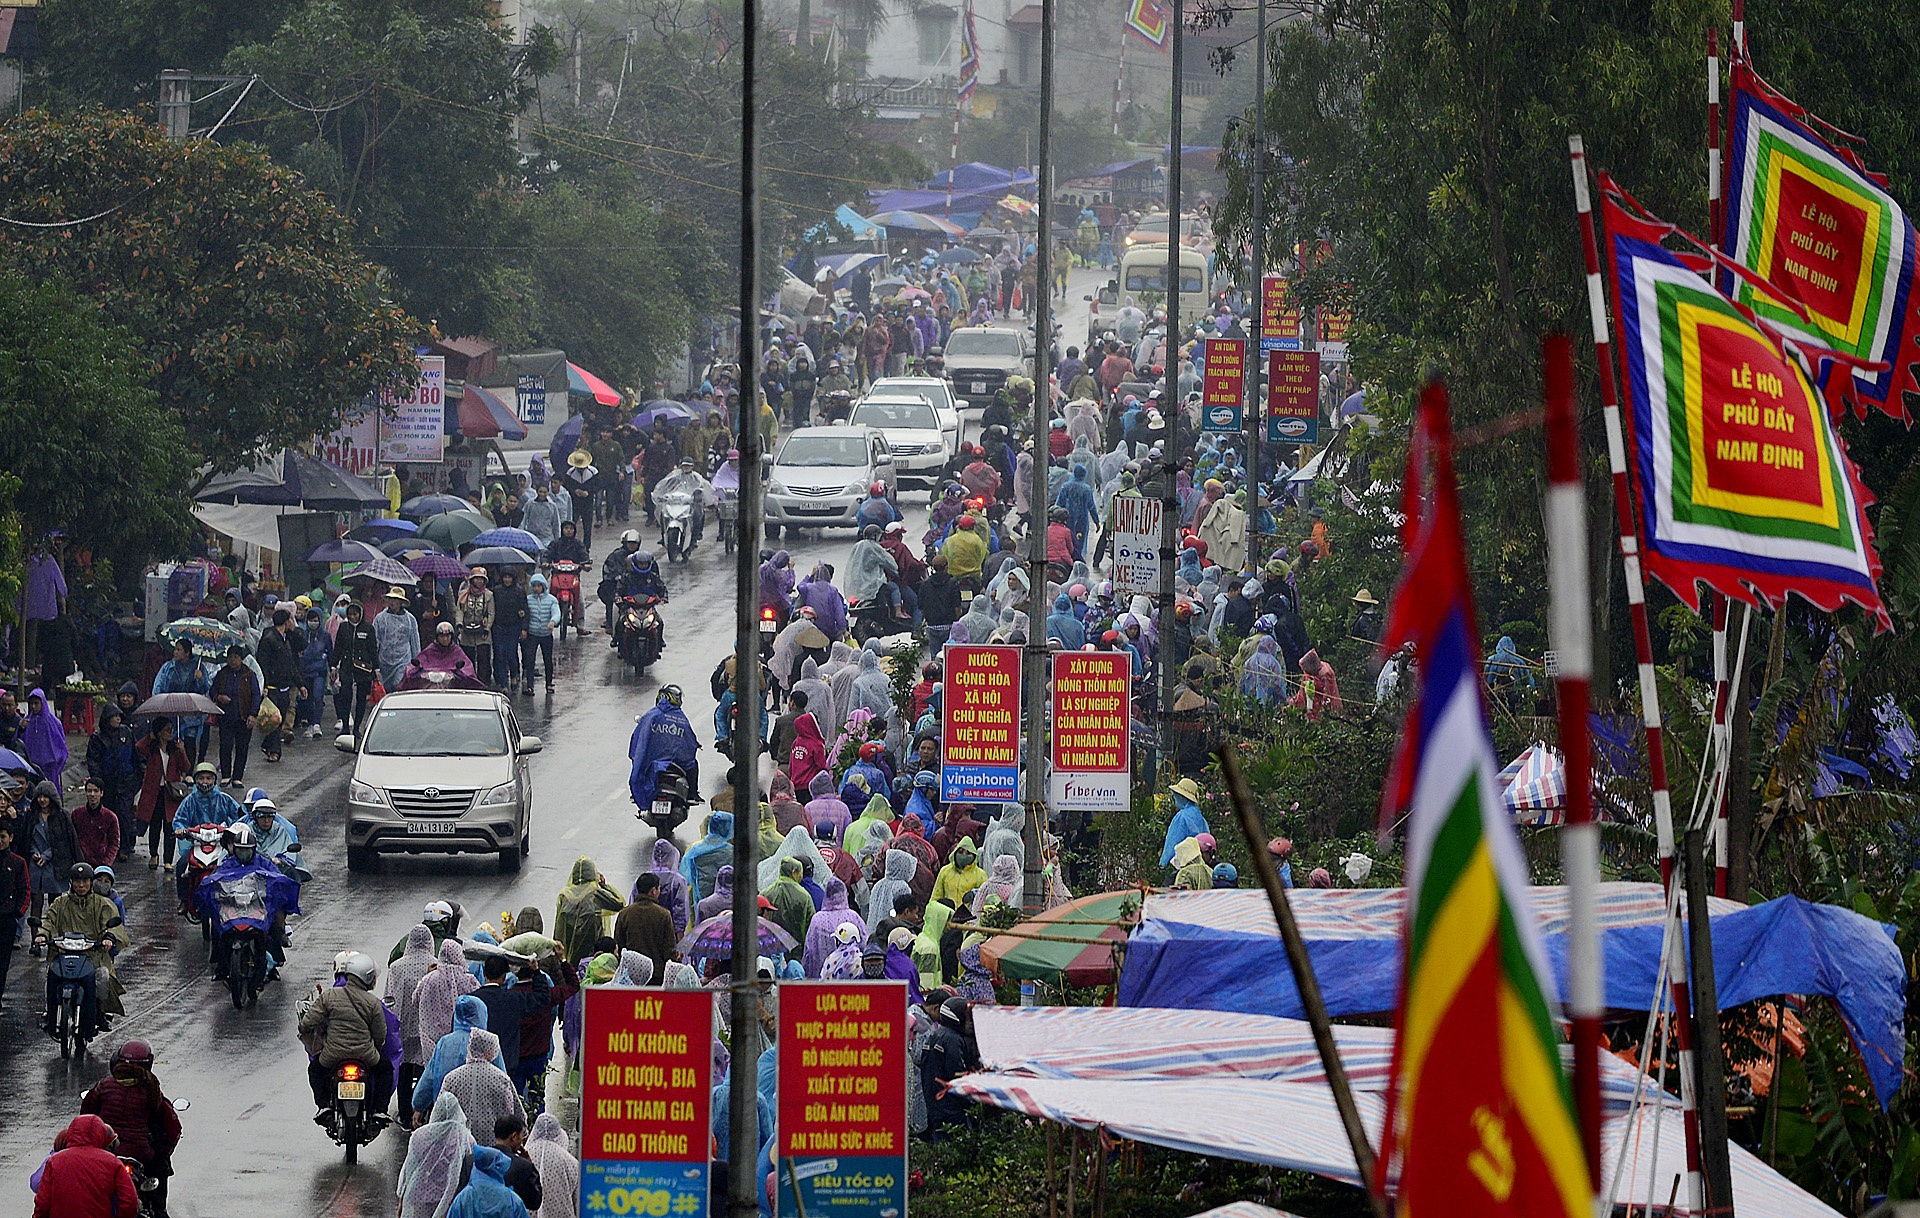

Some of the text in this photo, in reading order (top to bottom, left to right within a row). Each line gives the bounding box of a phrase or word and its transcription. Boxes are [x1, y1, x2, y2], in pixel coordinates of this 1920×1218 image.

[1802, 203, 1838, 232] LỄ HỘI
[1790, 230, 1814, 251] PHỦ
[1784, 257, 1838, 293] NAM ĐỊNH
[1215, 343, 1222, 351] AN
[1264, 338, 1297, 349] vinaphone
[1211, 356, 1222, 364] GIAO
[1278, 364, 1293, 372] LÀM
[1732, 362, 1783, 399] LỄ HỘI
[421, 383, 440, 405] BÒ
[519, 394, 531, 422] XE
[1723, 397, 1759, 426] PHỦ
[1717, 439, 1804, 470] NAM ĐỊNH
[1116, 565, 1130, 584] XE
[968, 652, 999, 667] NƯỚC
[1070, 658, 1113, 677] XÂY DỰNG
[956, 670, 1011, 688] CỘNG HÒA
[1058, 677, 1125, 693] NÔNG THÔN MỚI
[965, 690, 1001, 707] XÃ HỘI
[1062, 696, 1120, 713] LÀ SỰ NGHIỆP
[954, 706, 1012, 724] CHỦ NGHĨA
[1058, 713, 1124, 731] CỦA NHÂN DÂN,
[956, 726, 1008, 744] VIỆT NAM
[1060, 733, 1121, 749] DO NHÂN DÂN,
[948, 745, 1014, 761] MUÔN NĂM!
[1062, 750, 1119, 766] VÌ NHÂN DÂN.
[947, 772, 1015, 787] vinaphone
[1065, 780, 1116, 800] Fibervnn
[634, 996, 663, 1020] HÃY
[816, 993, 870, 1016] LỰA CHỌN
[796, 1015, 891, 1043] THỰC PHẨM SẠCH
[608, 1029, 687, 1054] NÓI KHÔNG
[803, 1046, 818, 1067] RÕ
[860, 1044, 883, 1067] GỐC
[598, 1062, 697, 1091] VỚI RƯỢU, BIA
[808, 1071, 836, 1094] XUẤT
[856, 1077, 878, 1094] CHO
[597, 1099, 695, 1121] KHI THAM GIA
[805, 1102, 879, 1122] BỮA ĂN NGON
[603, 1130, 688, 1154] GIAO THÔNG
[791, 1127, 894, 1149] AN TOÀN SỨC KHỎE
[813, 1172, 895, 1190] SIÊU TỐC ĐỘ
